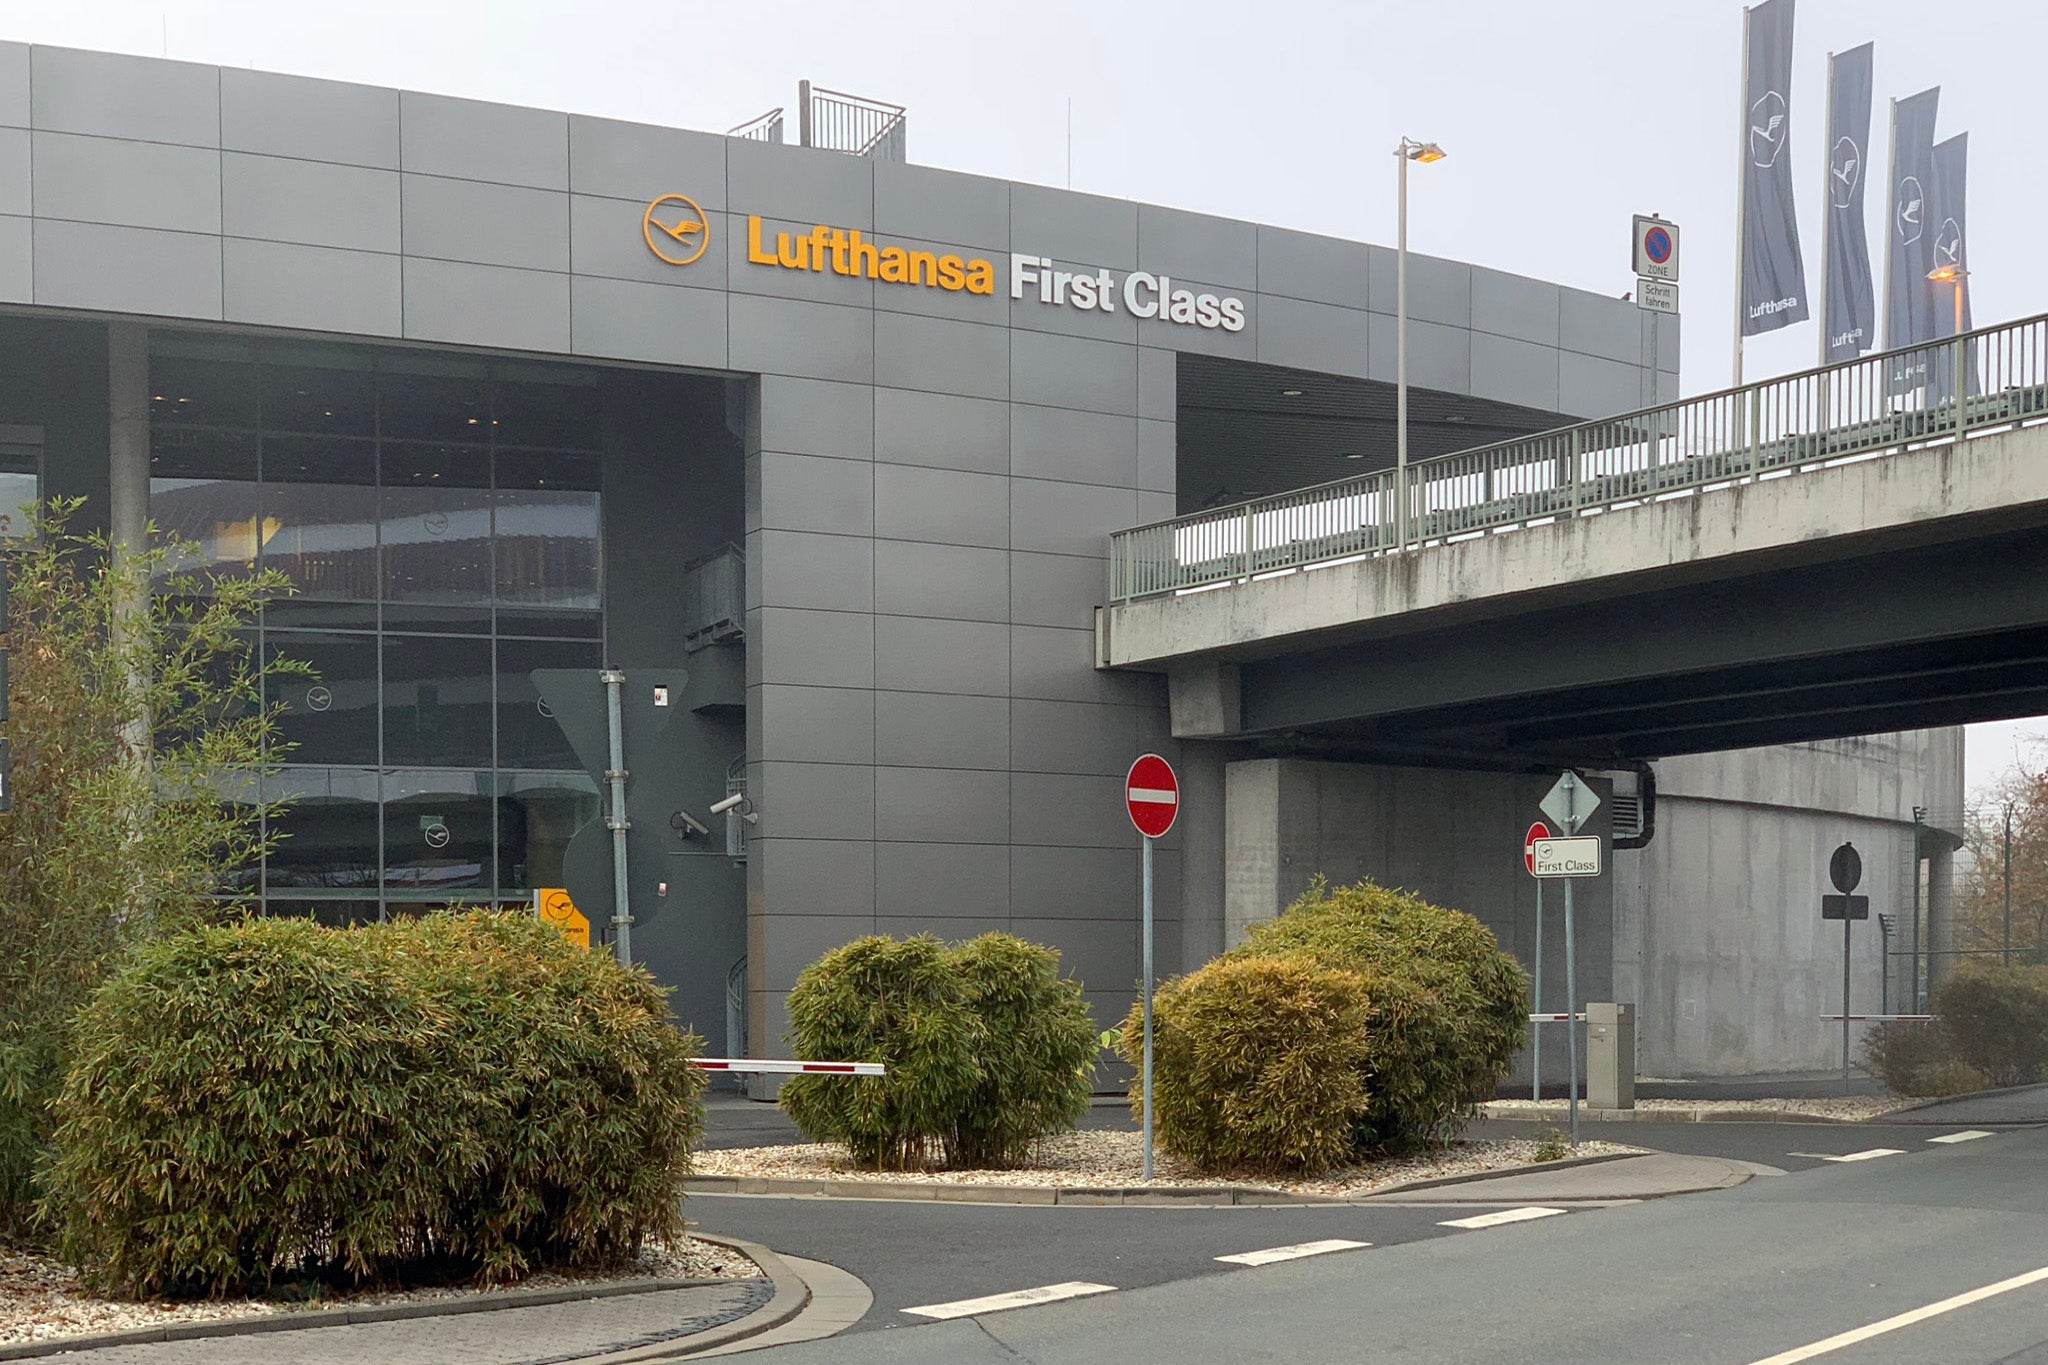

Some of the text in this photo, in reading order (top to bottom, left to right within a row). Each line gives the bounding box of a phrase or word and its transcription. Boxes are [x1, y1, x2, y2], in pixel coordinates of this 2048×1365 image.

[748, 215, 1245, 332] Lufthansa First Class
[1648, 264, 1668, 276] ZONE
[1645, 284, 1671, 297] Schritt
[1645, 296, 1670, 309] fahren
[1538, 860, 1595, 872] First Class
